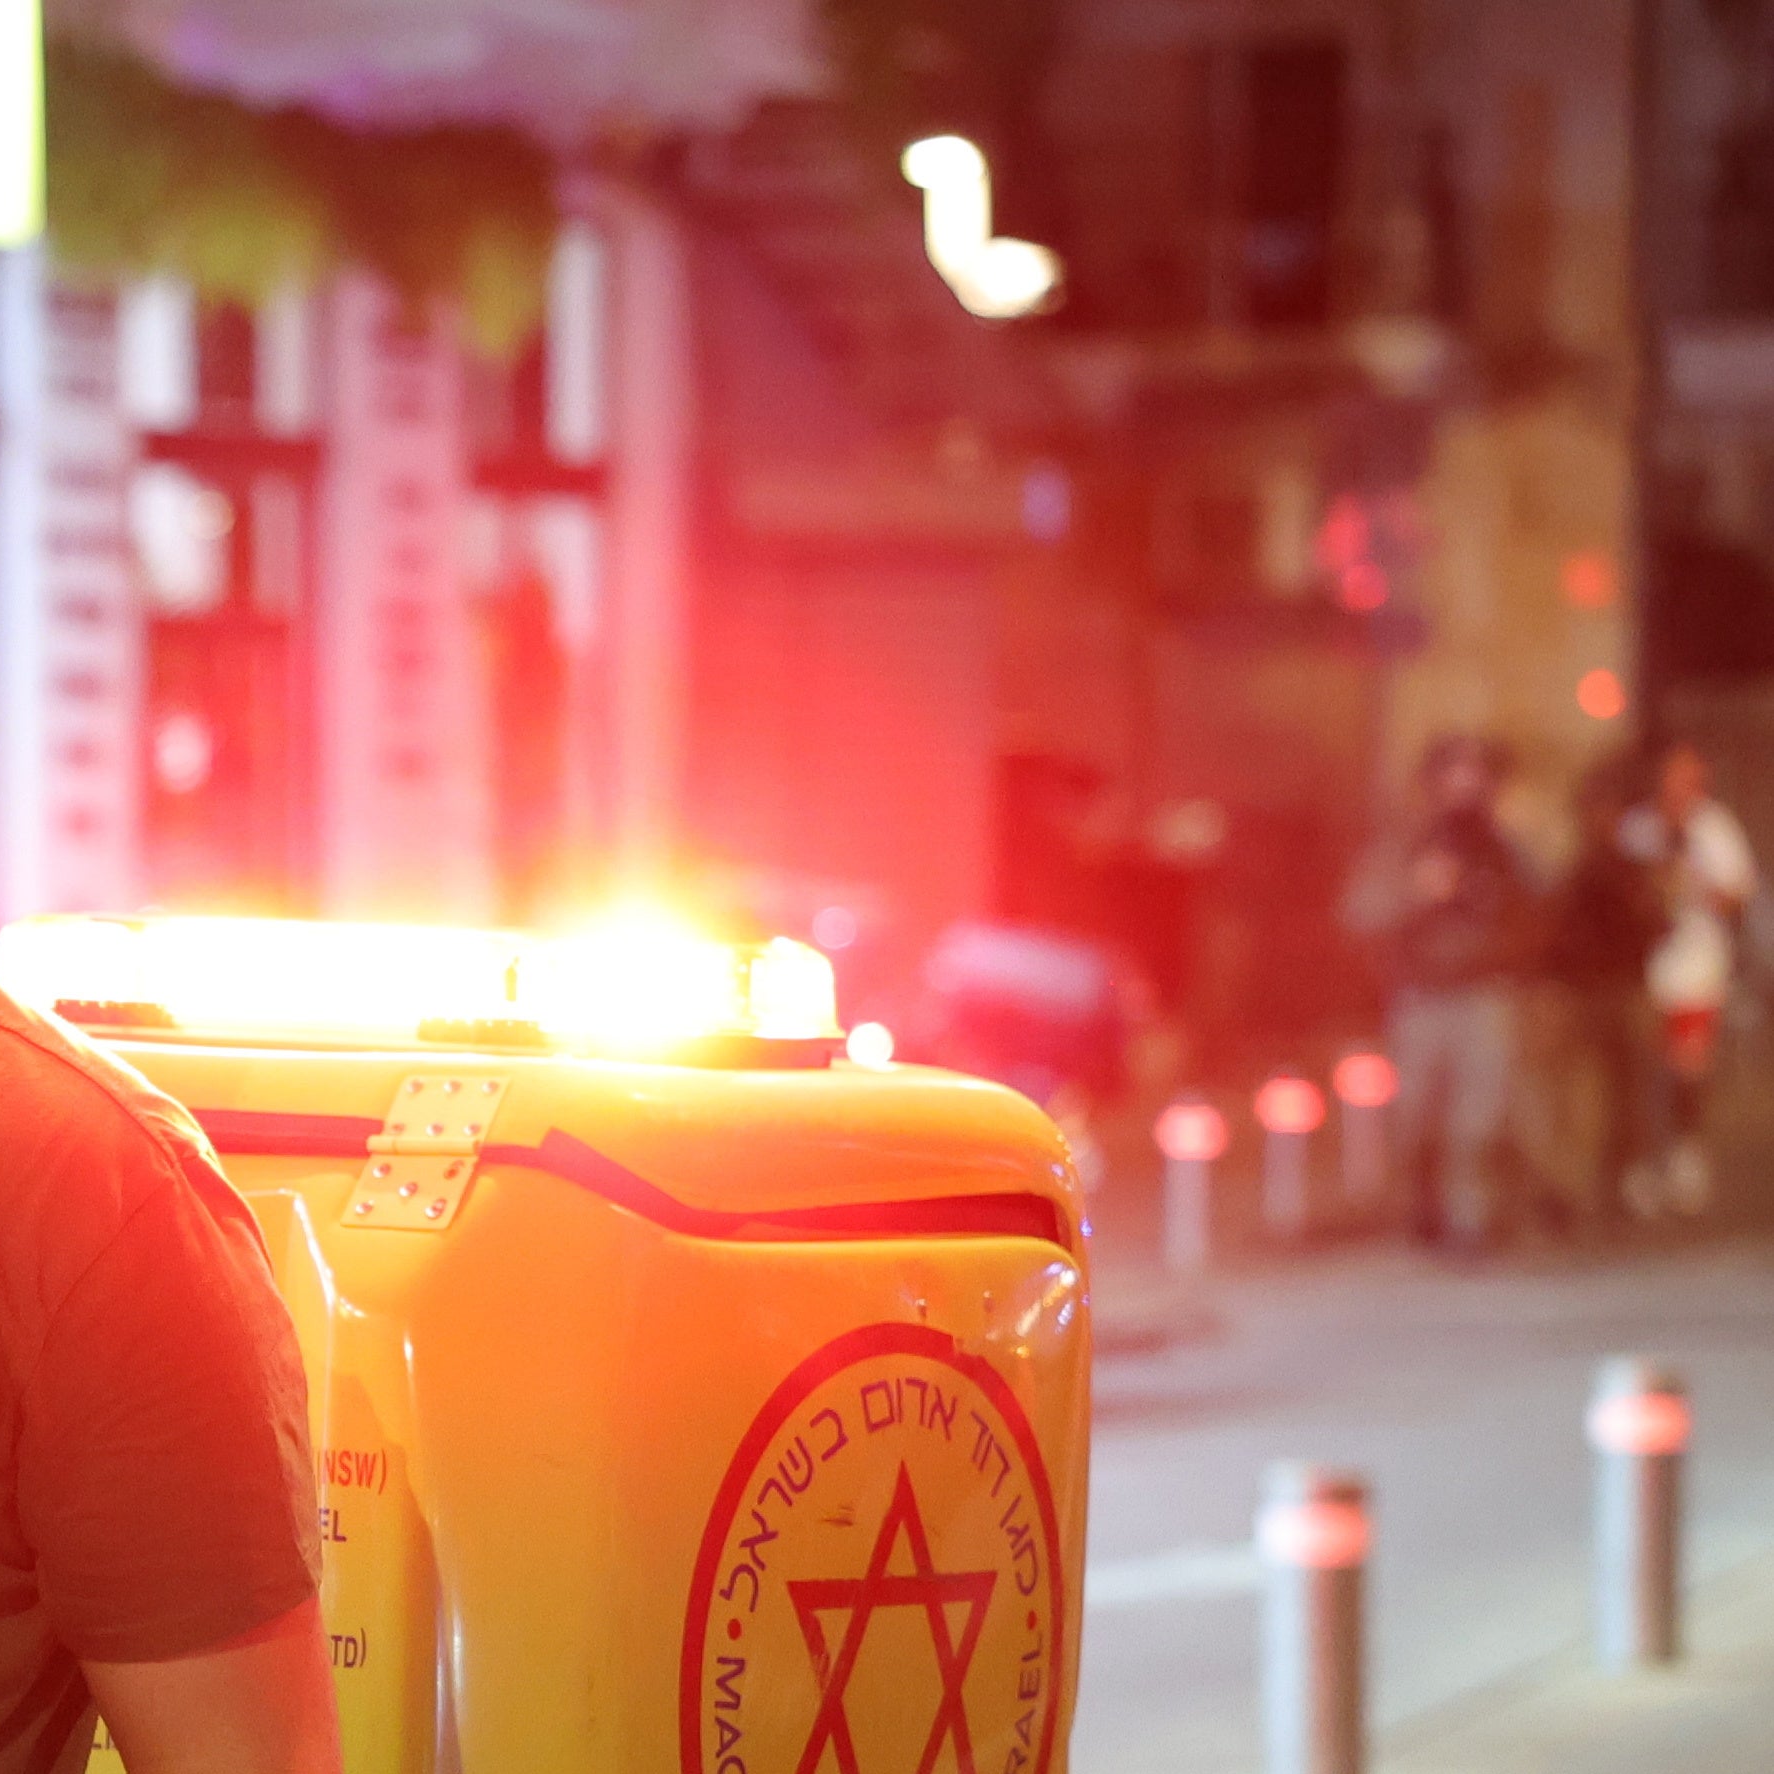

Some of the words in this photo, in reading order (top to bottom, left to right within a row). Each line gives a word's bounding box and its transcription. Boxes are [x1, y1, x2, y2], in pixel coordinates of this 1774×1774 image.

[860, 1377, 958, 1441] אדום
[970, 1410, 1012, 1498] דוד
[999, 1494, 1039, 1596] מגן
